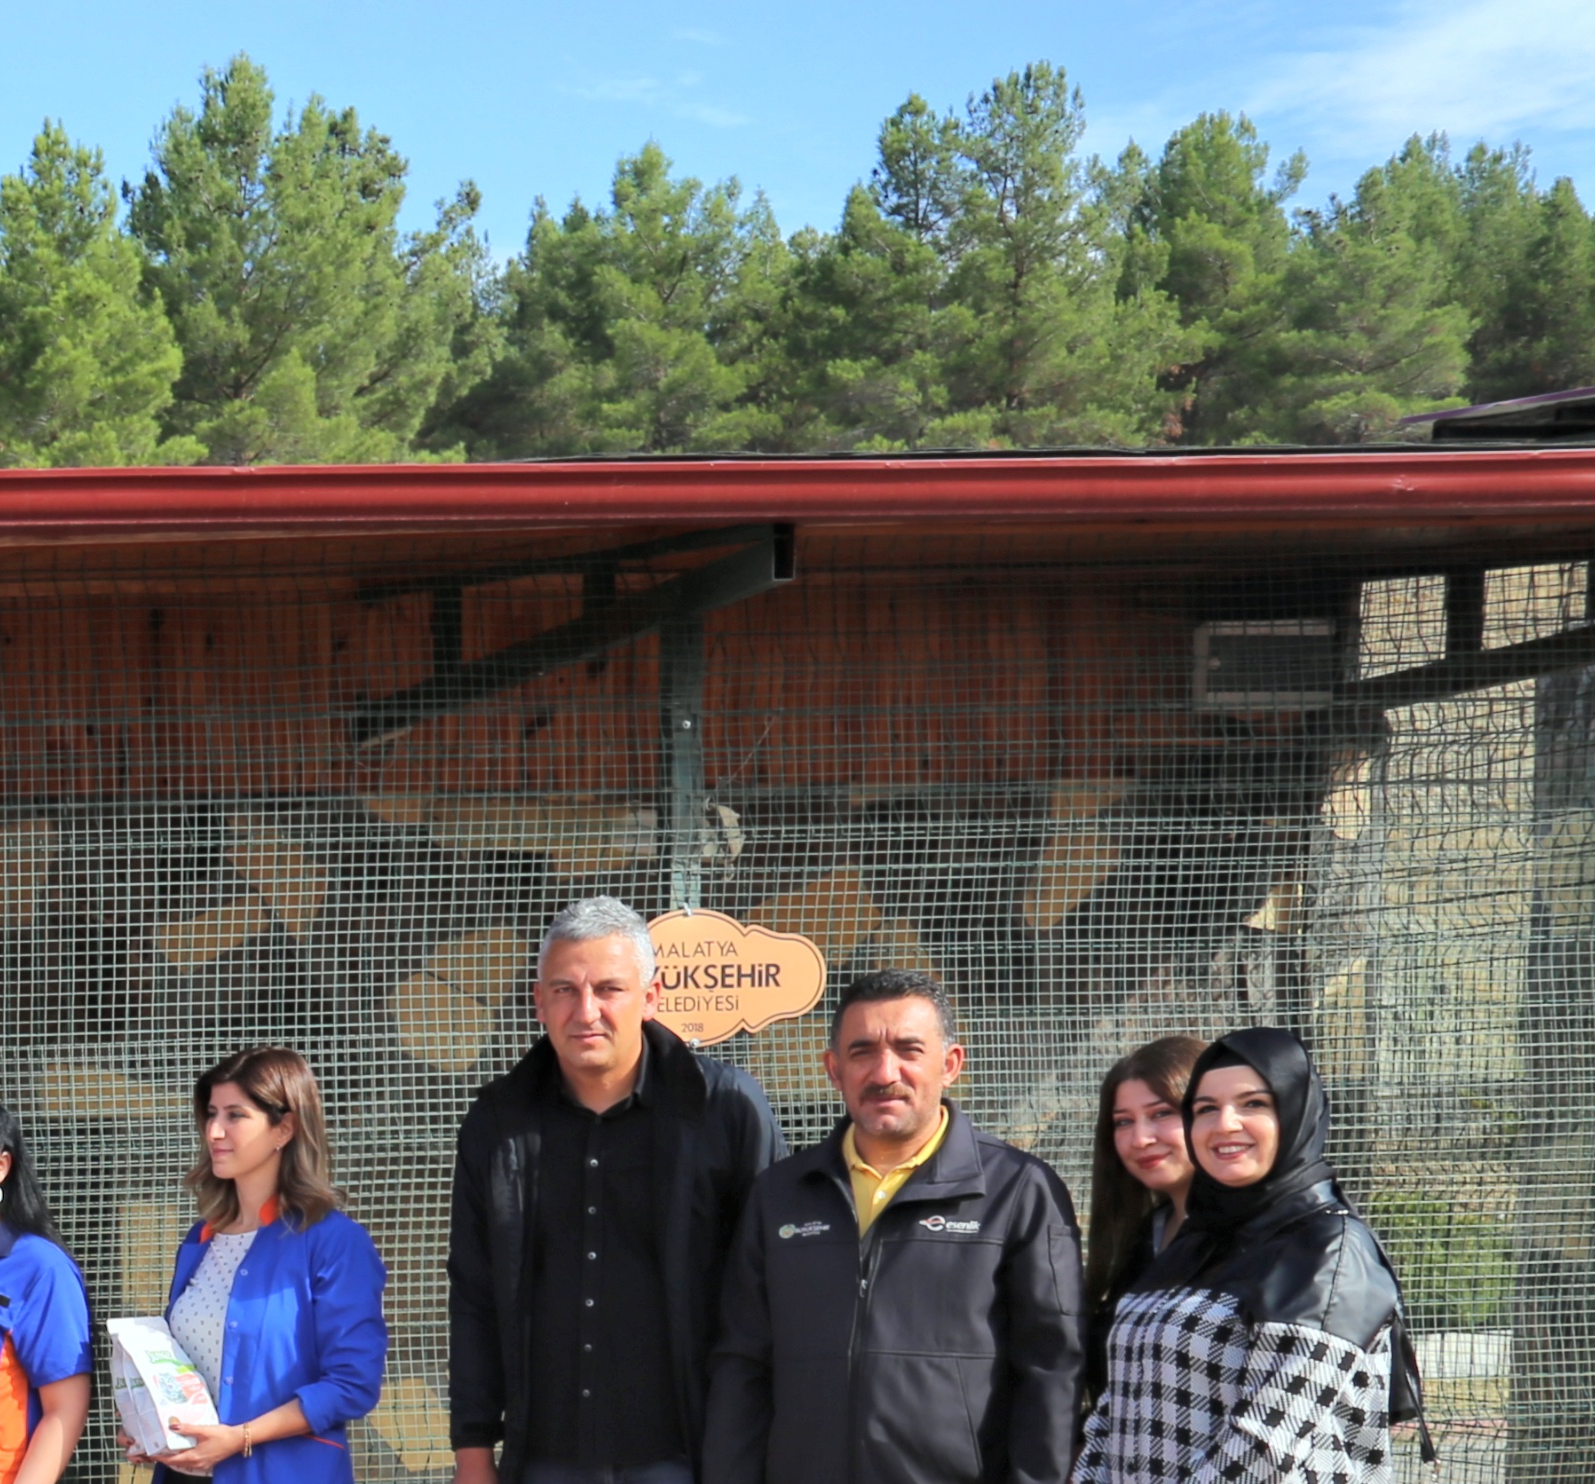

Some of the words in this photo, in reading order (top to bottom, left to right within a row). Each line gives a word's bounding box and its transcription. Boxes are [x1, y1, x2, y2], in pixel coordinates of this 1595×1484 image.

[654, 940, 739, 958] MALATYA
[654, 963, 781, 993] ÜKŞEHİR
[656, 995, 740, 1013] ELEDİYESİ
[680, 1022, 704, 1034] 2018
